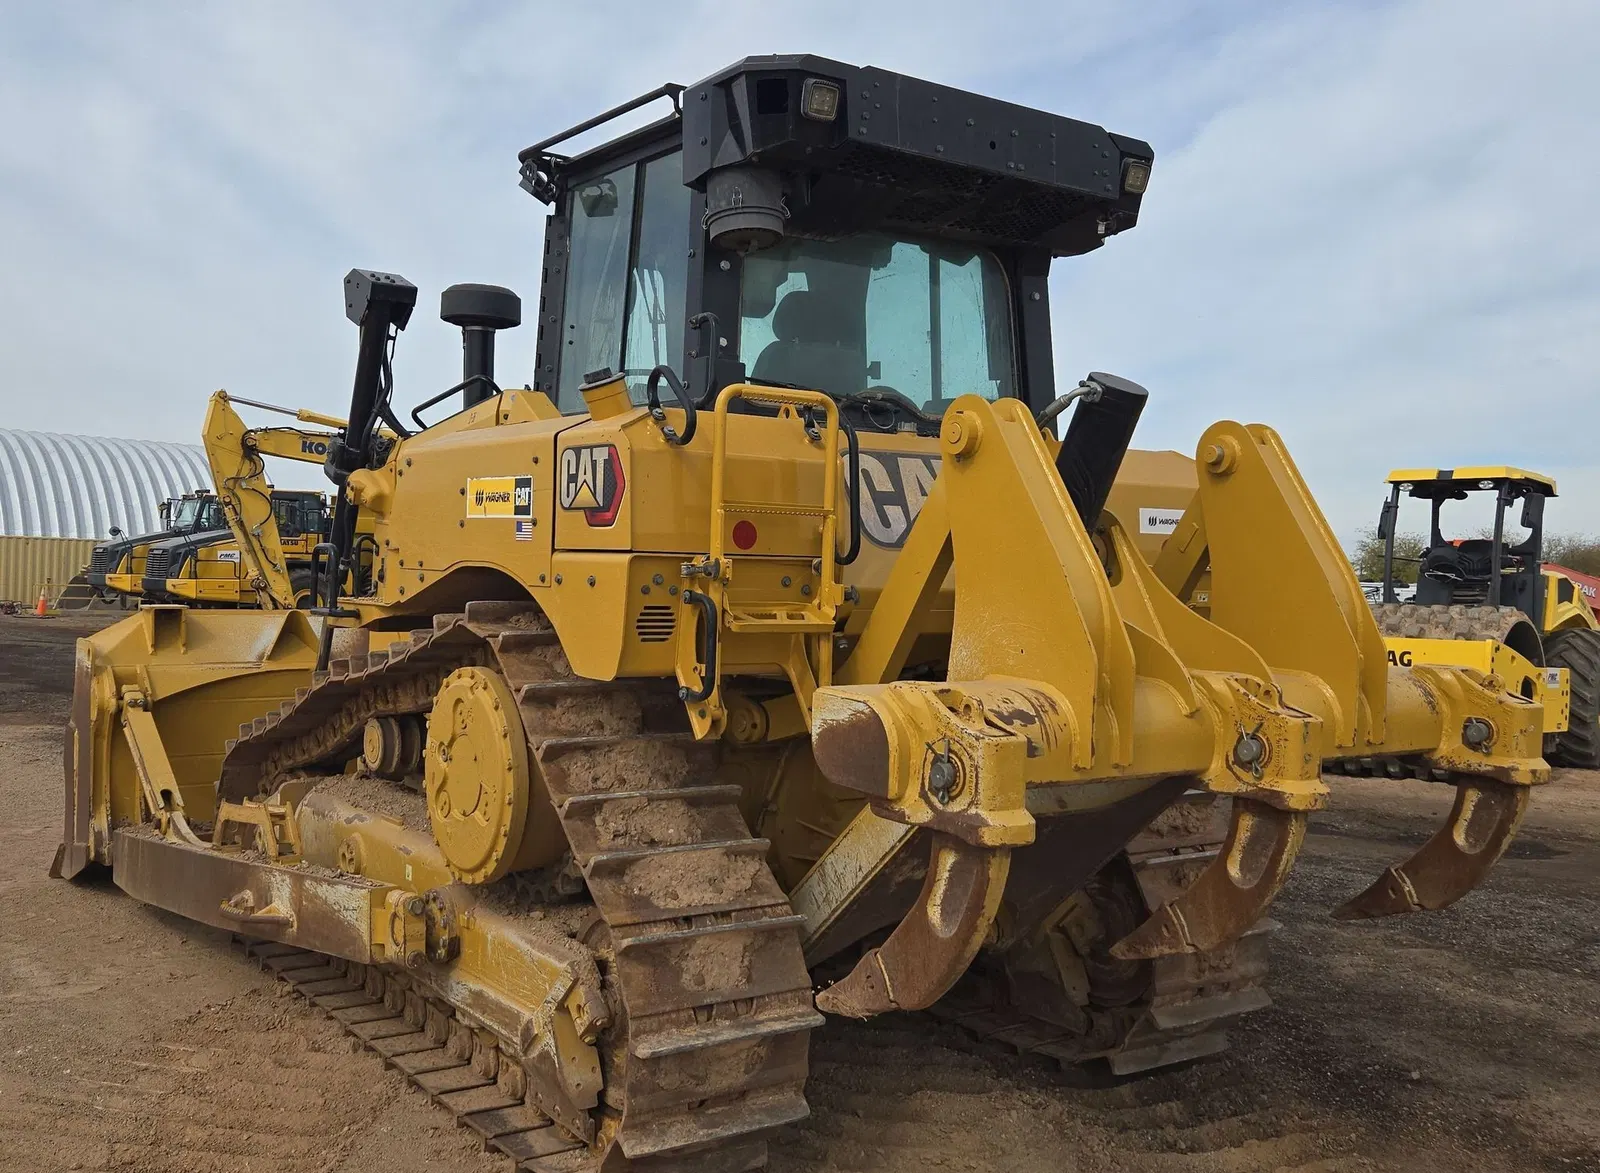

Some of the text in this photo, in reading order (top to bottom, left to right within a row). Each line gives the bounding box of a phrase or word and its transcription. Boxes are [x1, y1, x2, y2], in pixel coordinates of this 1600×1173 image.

[301, 440, 330, 455] KO
[485, 487, 531, 506] WAGNER CAT
[561, 446, 609, 508] CAT
[842, 453, 943, 544] CA
